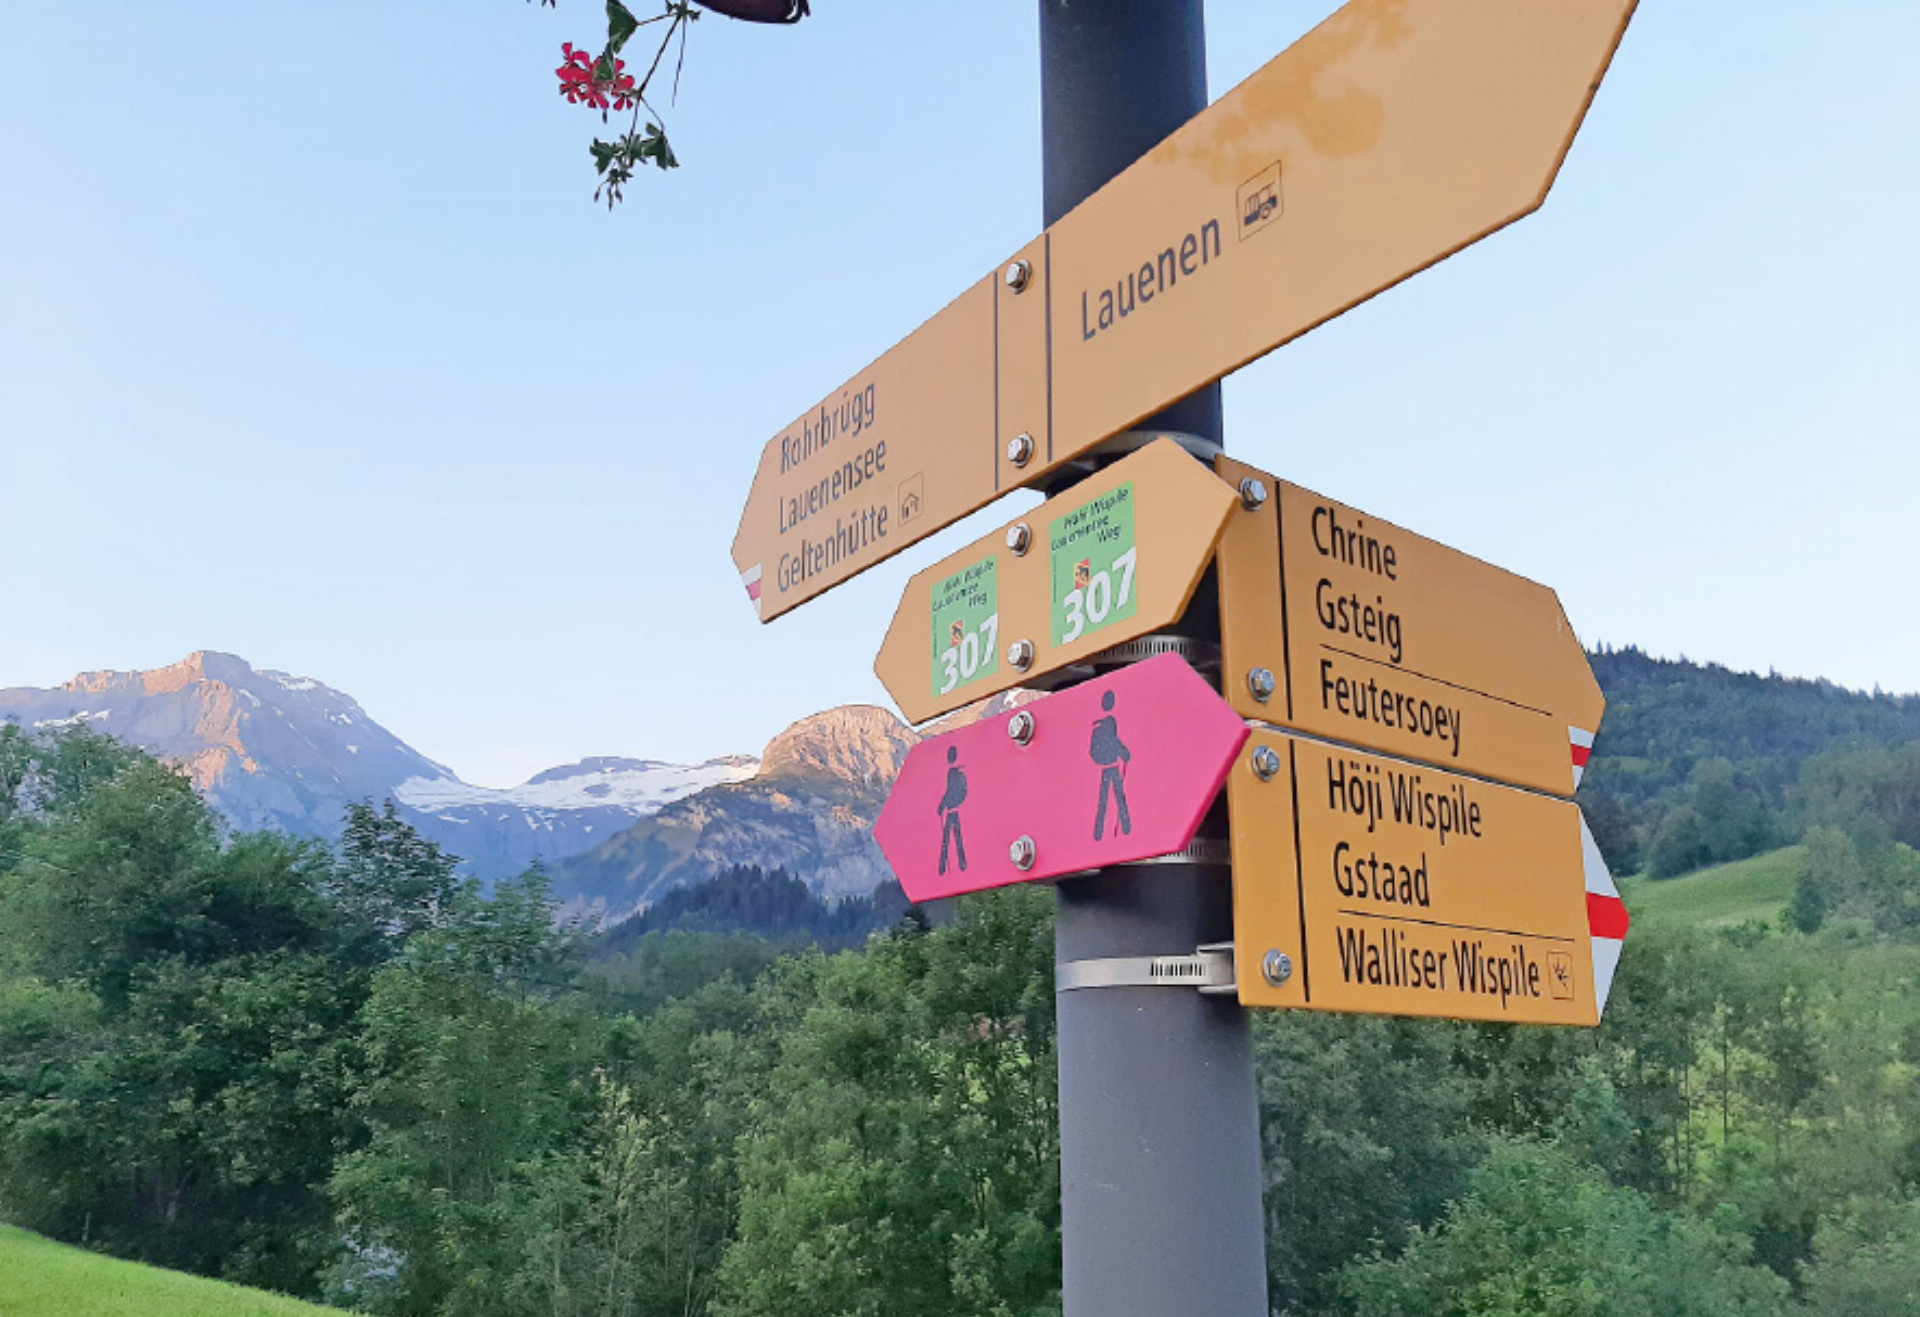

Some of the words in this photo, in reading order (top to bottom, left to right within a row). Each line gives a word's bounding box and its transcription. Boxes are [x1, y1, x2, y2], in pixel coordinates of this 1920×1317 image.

[1082, 218, 1221, 342] Lauenen
[779, 440, 887, 535] Lauenensee
[777, 504, 889, 593] Geltenhütte
[1311, 506, 1398, 581] Chrine
[1061, 546, 1137, 645] 307
[1316, 578, 1402, 664] Gsteig
[940, 612, 999, 695] 307
[1319, 658, 1461, 758] Feutersoey
[1327, 757, 1383, 833] Höji
[1387, 770, 1482, 846] Wispile
[1333, 841, 1430, 908] Gstaad
[1336, 925, 1448, 990] Walliser
[1452, 939, 1541, 1010] Wispile
